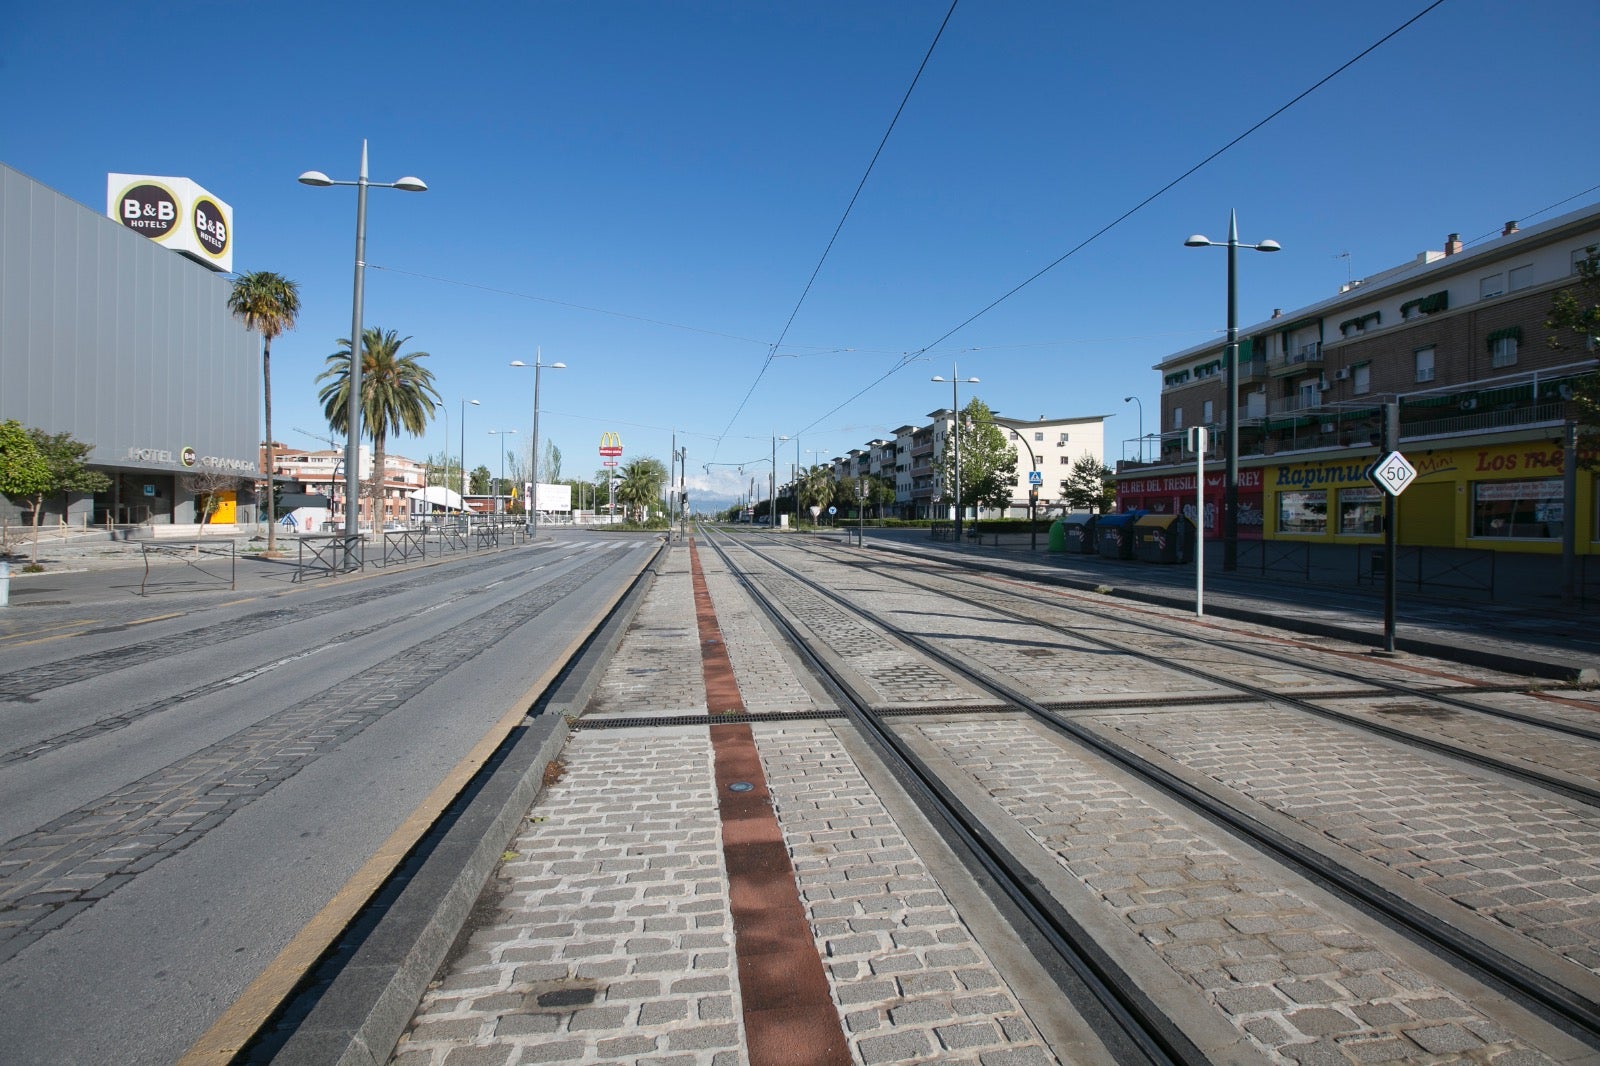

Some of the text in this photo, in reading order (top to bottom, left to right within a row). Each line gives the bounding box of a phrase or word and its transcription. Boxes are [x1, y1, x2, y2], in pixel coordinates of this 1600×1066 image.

[124, 199, 175, 220] B&B
[131, 220, 167, 229] HOTELS
[196, 209, 226, 242] B&B
[200, 232, 222, 248] HOTELS
[128, 448, 176, 462] HOTEL
[202, 456, 255, 471] GRANADA
[1417, 455, 1453, 475] Mini
[1475, 451, 1517, 472] Los
[1237, 471, 1260, 487] REY
[1386, 466, 1406, 481] 50
[1121, 475, 1204, 494] EL REY DEL TRESILL
